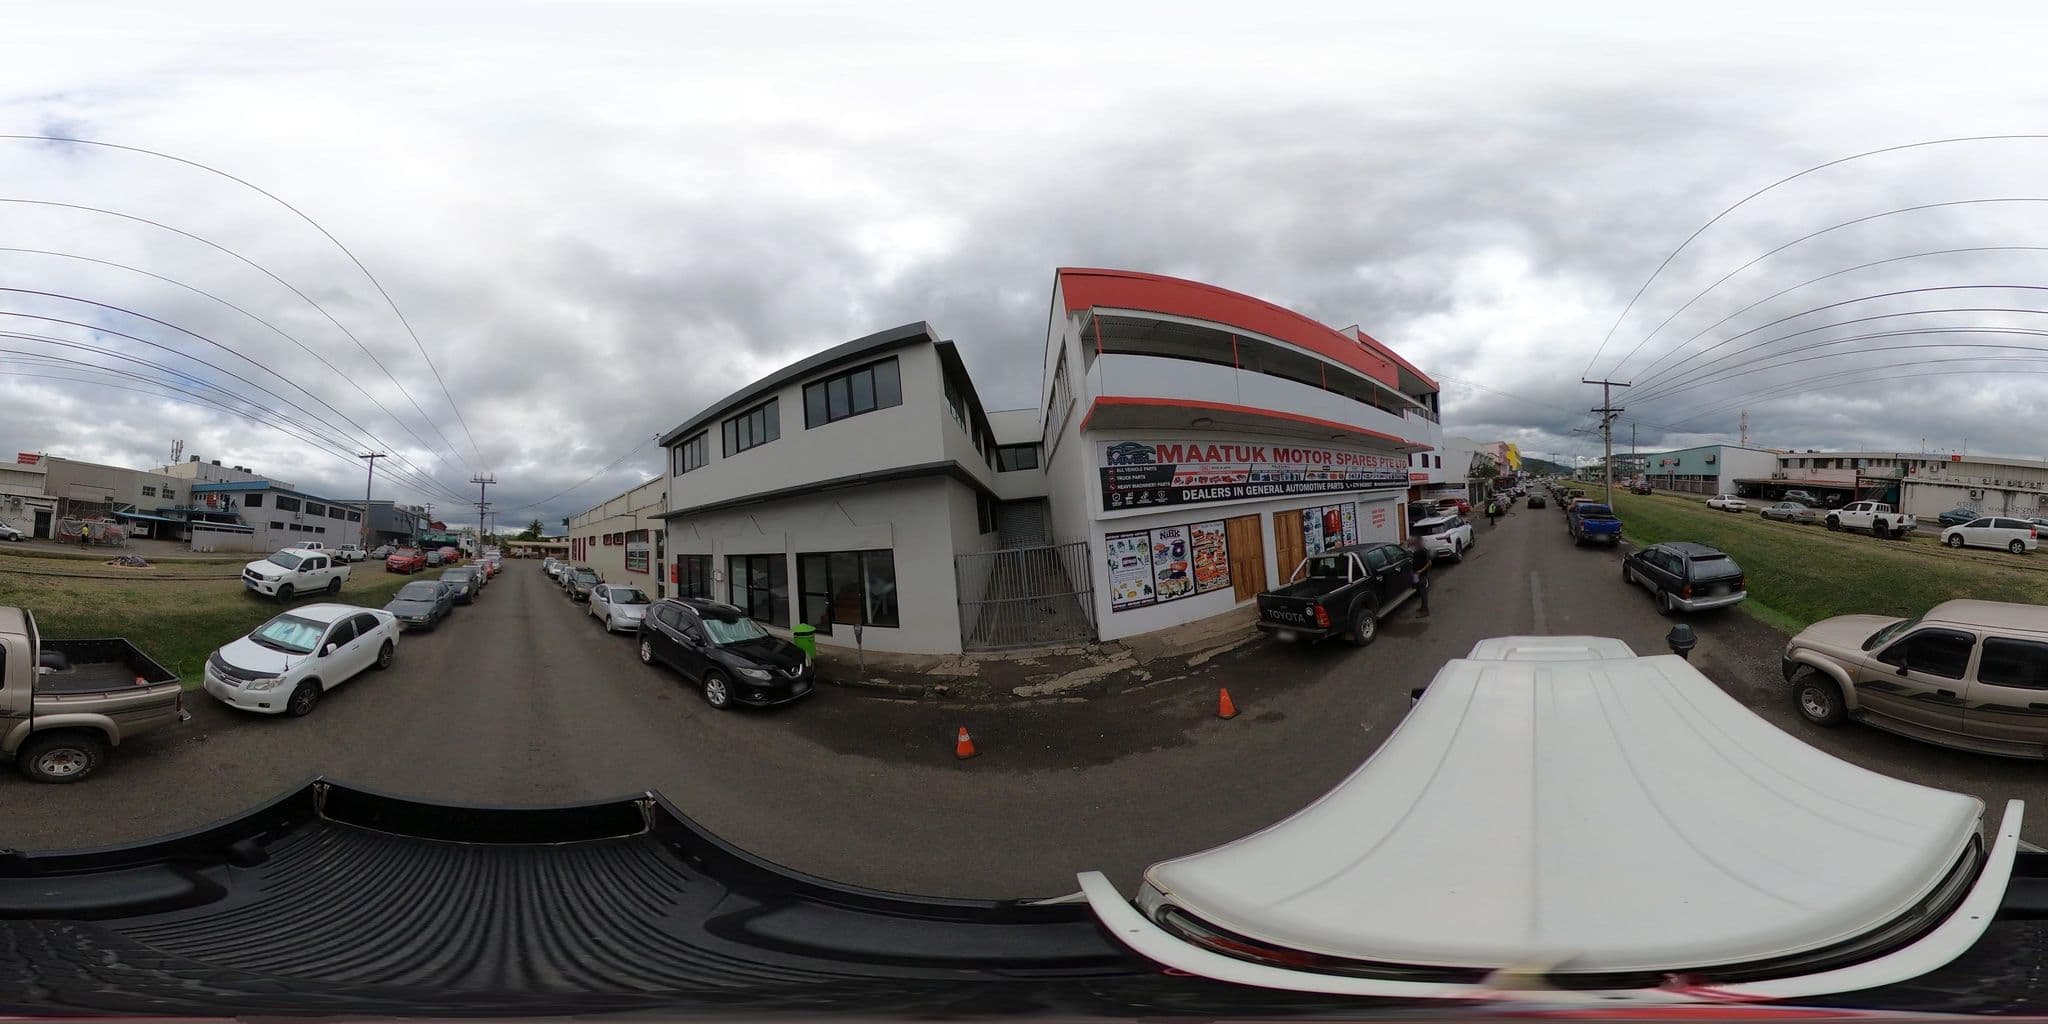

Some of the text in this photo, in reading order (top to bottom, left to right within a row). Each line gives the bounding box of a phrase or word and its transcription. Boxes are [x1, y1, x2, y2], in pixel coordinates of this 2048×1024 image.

[1156, 444, 1267, 464] MAATUK
[1273, 447, 1333, 464] MOTOR
[1336, 453, 1378, 467] SPARES
[1379, 457, 1394, 467] PTE
[1396, 458, 1407, 469] LTD
[1183, 487, 1231, 500] DEALERS
[1234, 486, 1244, 496] IN
[1246, 484, 1284, 496] GENERAL
[1285, 482, 1326, 494] AUTOMOTIVE
[1327, 481, 1344, 490] PARTS
[1267, 608, 1306, 624] TOYOTA
